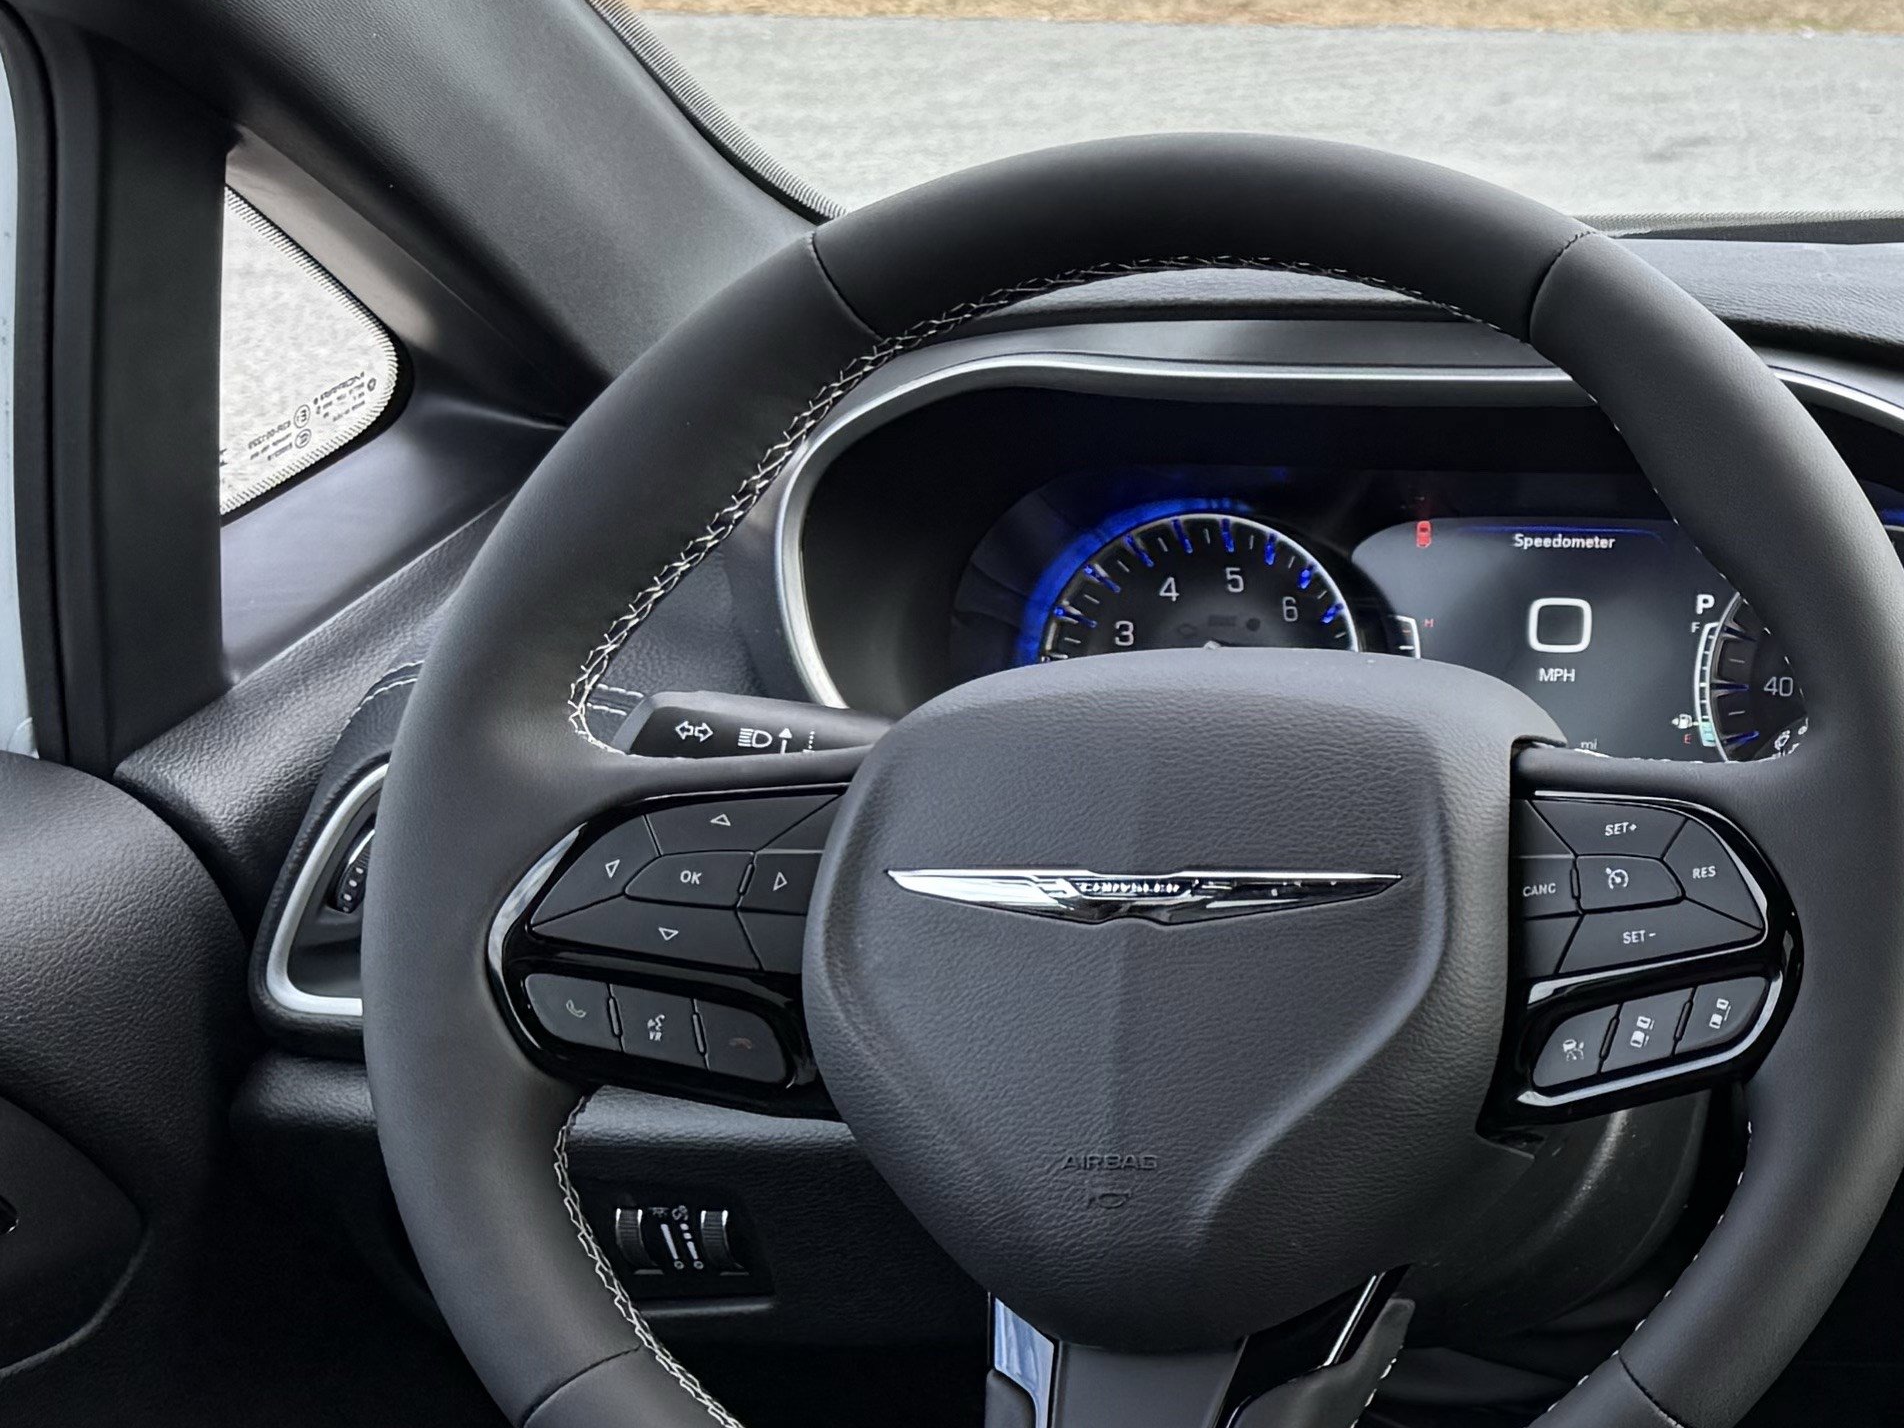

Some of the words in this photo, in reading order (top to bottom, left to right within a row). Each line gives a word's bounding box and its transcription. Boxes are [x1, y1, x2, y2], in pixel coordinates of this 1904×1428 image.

[1513, 533, 1616, 552] Speedometer
[1158, 576, 1180, 603] 4
[1226, 566, 1246, 593] 5
[1281, 595, 1299, 622] 6
[1697, 594, 1715, 615] P
[1114, 619, 1135, 647] 3
[1538, 667, 1576, 683] MPH
[1763, 675, 1795, 698] 40
[680, 869, 702, 886] OK
[1692, 865, 1717, 880] RES
[1522, 882, 1557, 898] CANC
[1062, 1153, 1159, 1171] AIRBAG
